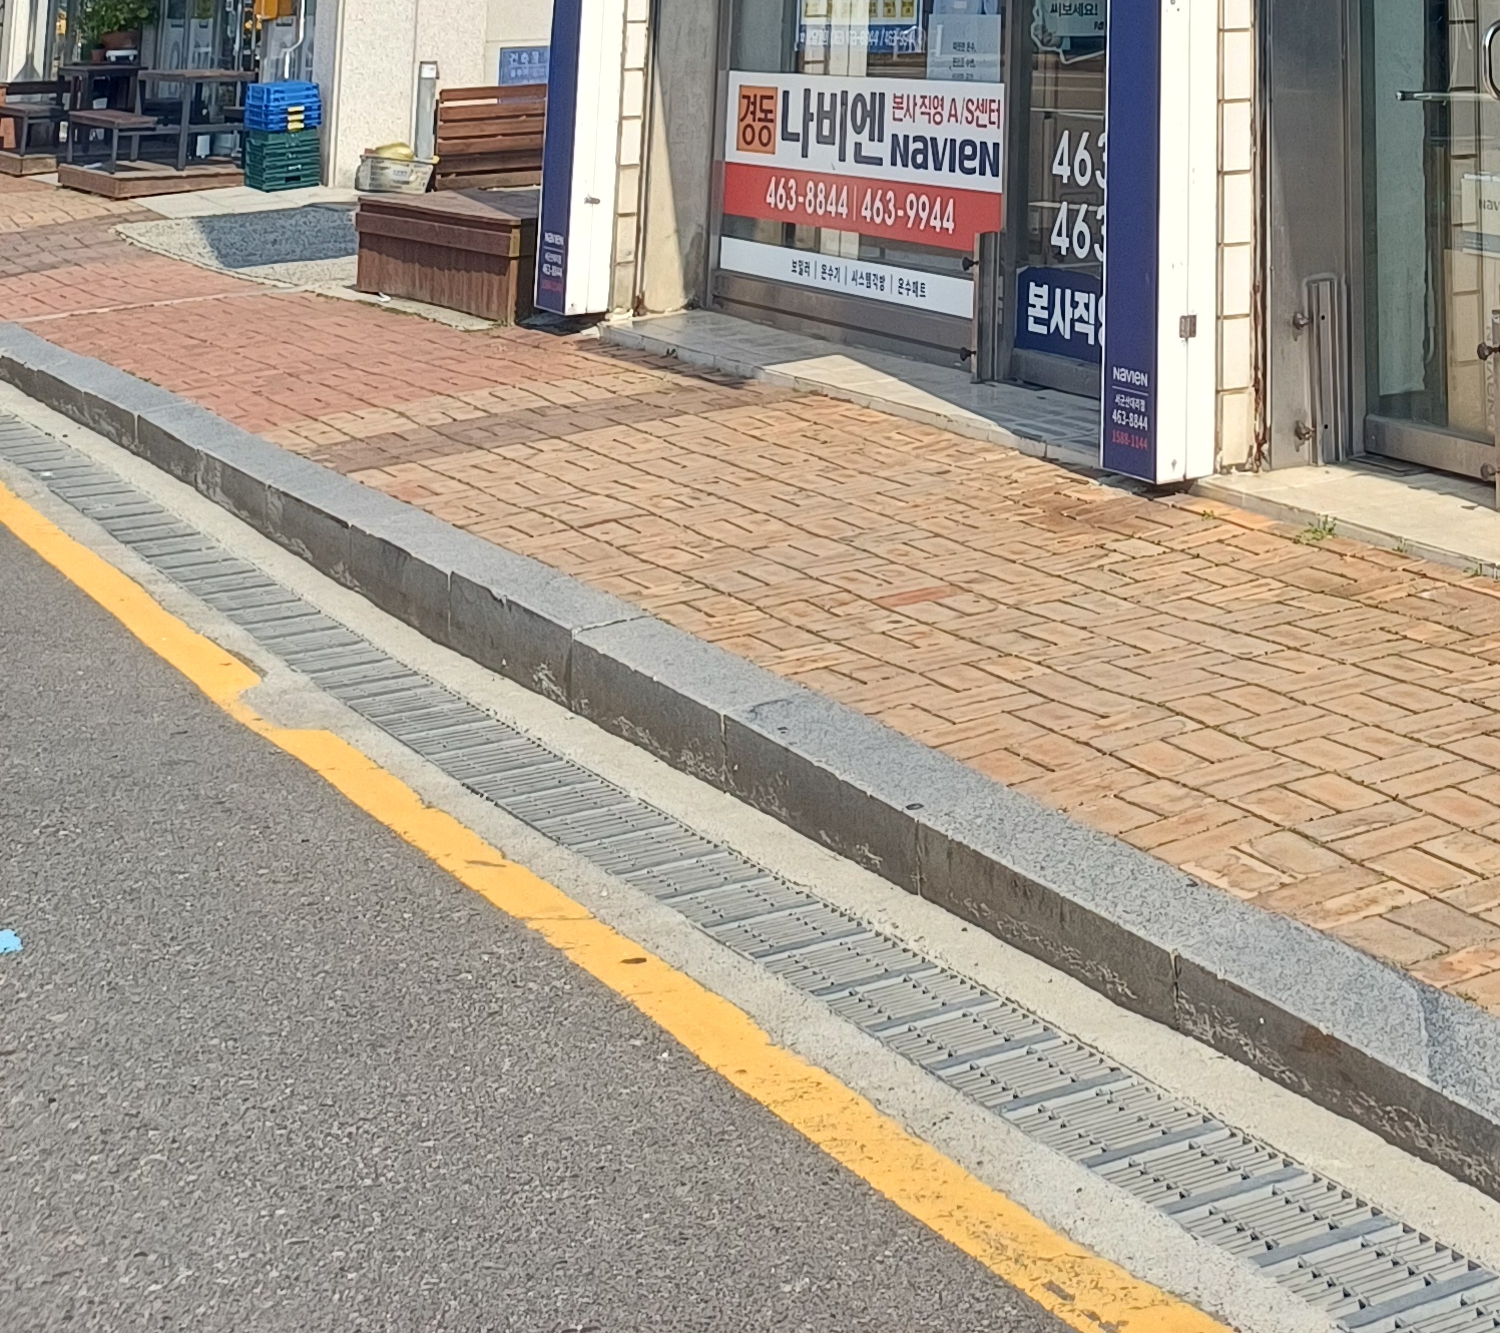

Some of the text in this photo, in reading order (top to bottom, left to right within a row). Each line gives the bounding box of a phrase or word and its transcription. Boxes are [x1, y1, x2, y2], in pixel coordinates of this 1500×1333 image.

[740, 94, 775, 147] 경동
[781, 88, 886, 167] 나비엔
[766, 176, 955, 235] 463-8844 463-9944
[1027, 281, 1105, 347] 본사직
[1112, 408, 1148, 431] 463-8844
